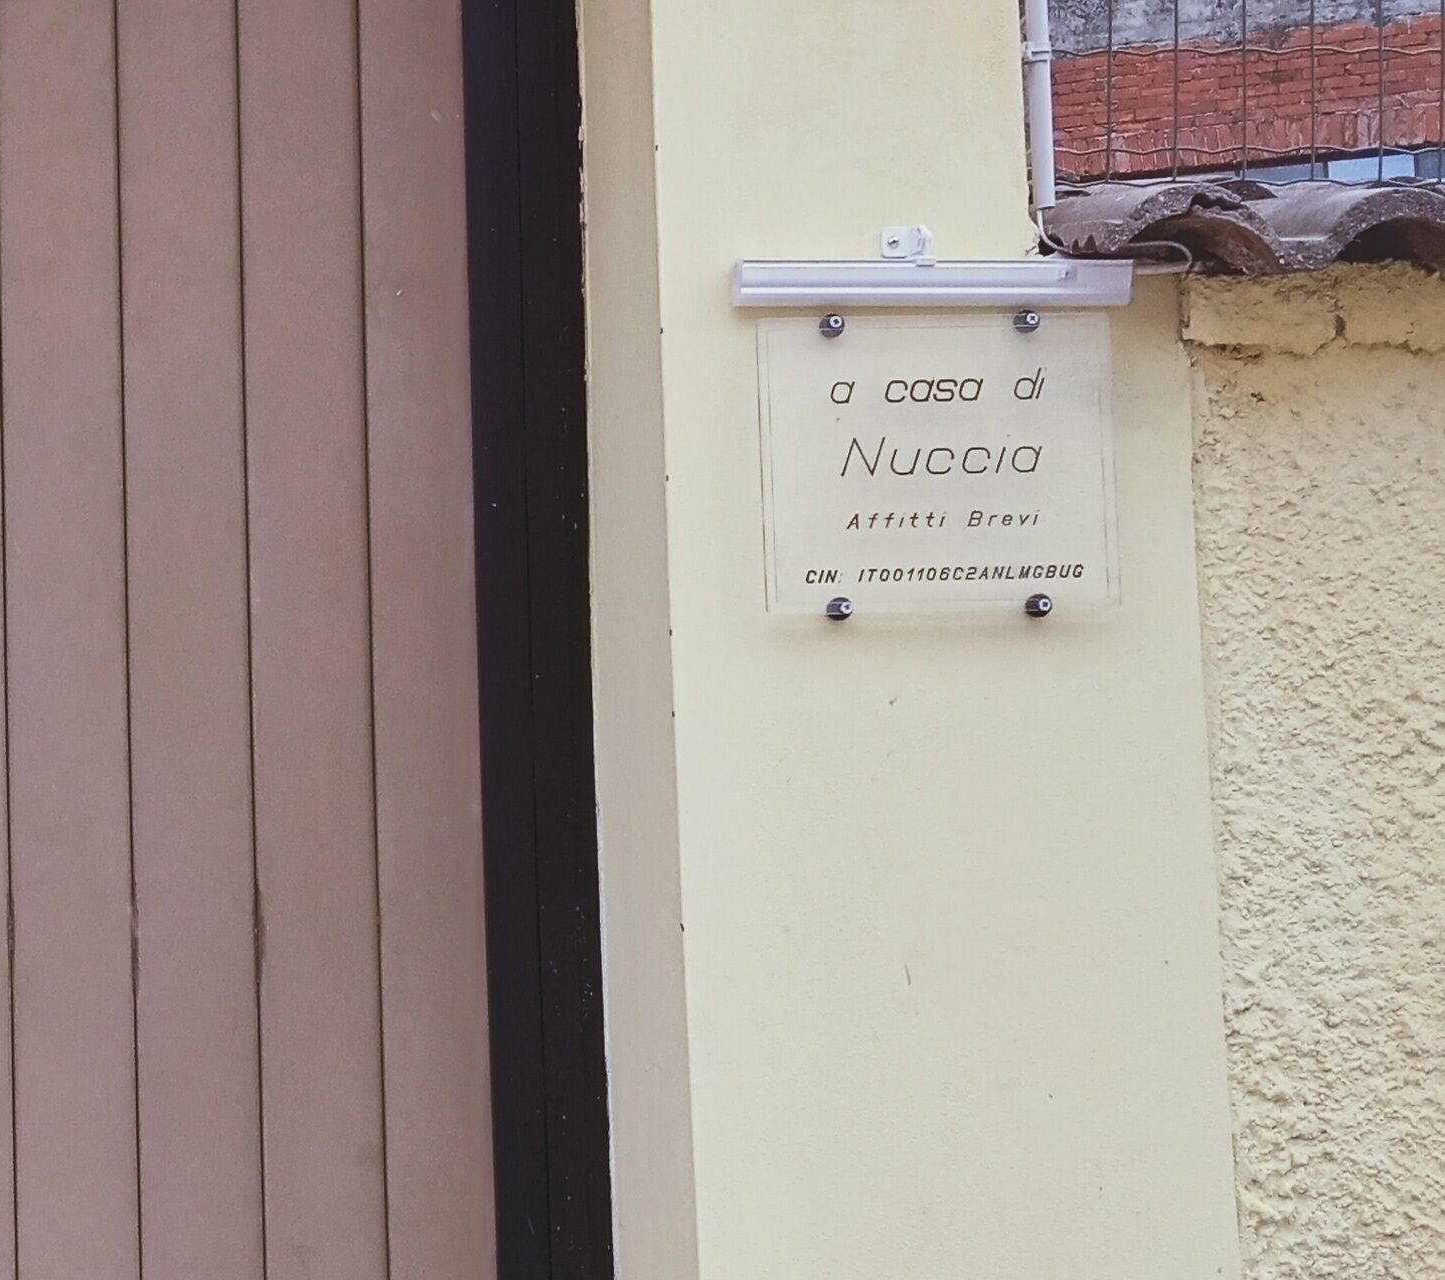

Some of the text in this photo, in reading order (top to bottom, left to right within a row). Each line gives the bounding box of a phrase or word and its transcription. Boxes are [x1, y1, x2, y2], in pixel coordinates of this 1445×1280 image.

[830, 367, 1045, 404] a casa di
[840, 437, 1042, 477] Nuccia
[846, 510, 1040, 530] Affitti Brevi
[805, 569, 842, 584] CIN:
